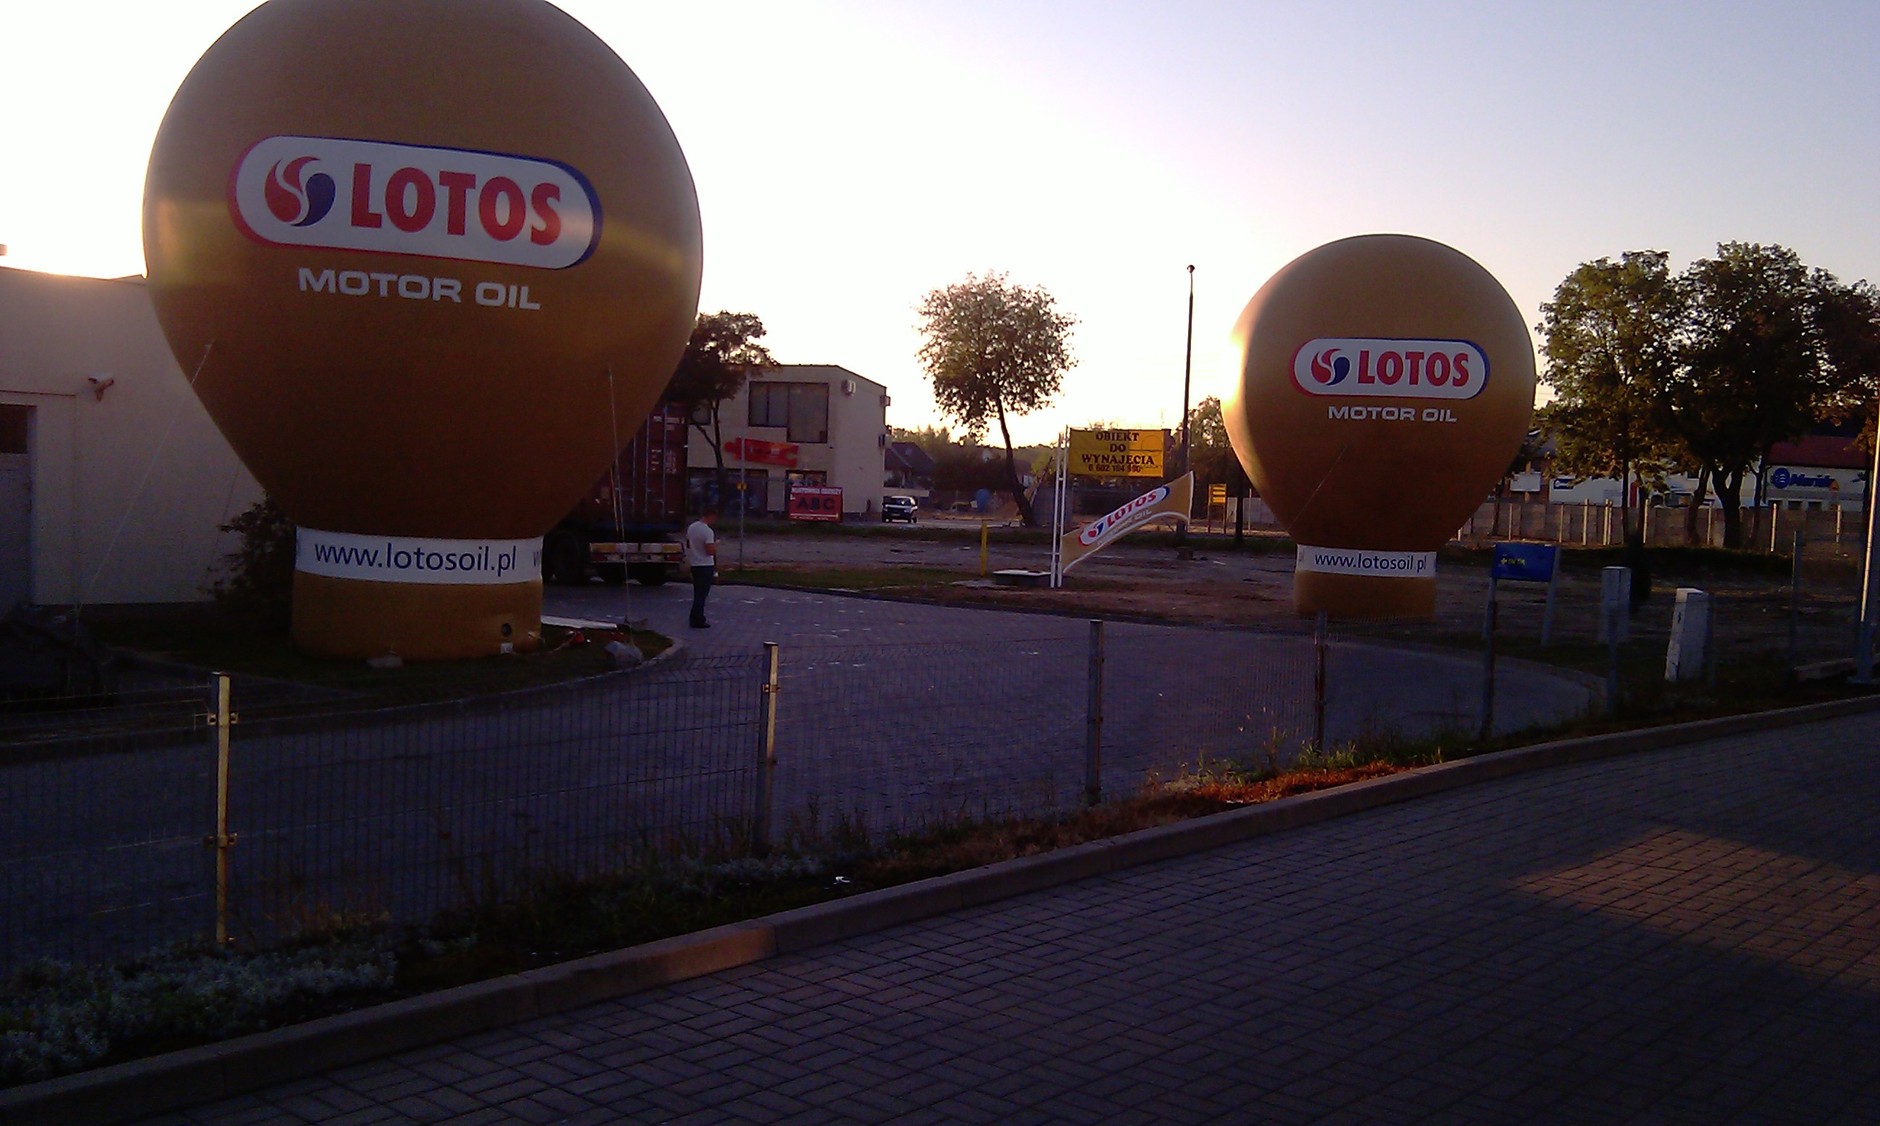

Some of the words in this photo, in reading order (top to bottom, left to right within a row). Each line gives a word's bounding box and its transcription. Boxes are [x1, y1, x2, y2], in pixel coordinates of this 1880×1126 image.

[350, 162, 562, 246] LOTOS
[298, 267, 463, 303] MOTOR
[474, 281, 541, 311] OIL
[1357, 350, 1469, 387] LOTOS
[1328, 405, 1416, 421] MOTOR
[1422, 408, 1458, 423] OIL
[1095, 431, 1140, 441] OBIEKT
[1109, 443, 1126, 453] DO
[796, 497, 836, 511] ABC
[1106, 490, 1158, 528] LOTOS
[314, 542, 517, 578] www.lotosoil.pl
[1314, 552, 1428, 574] www.lotosoil.pl
